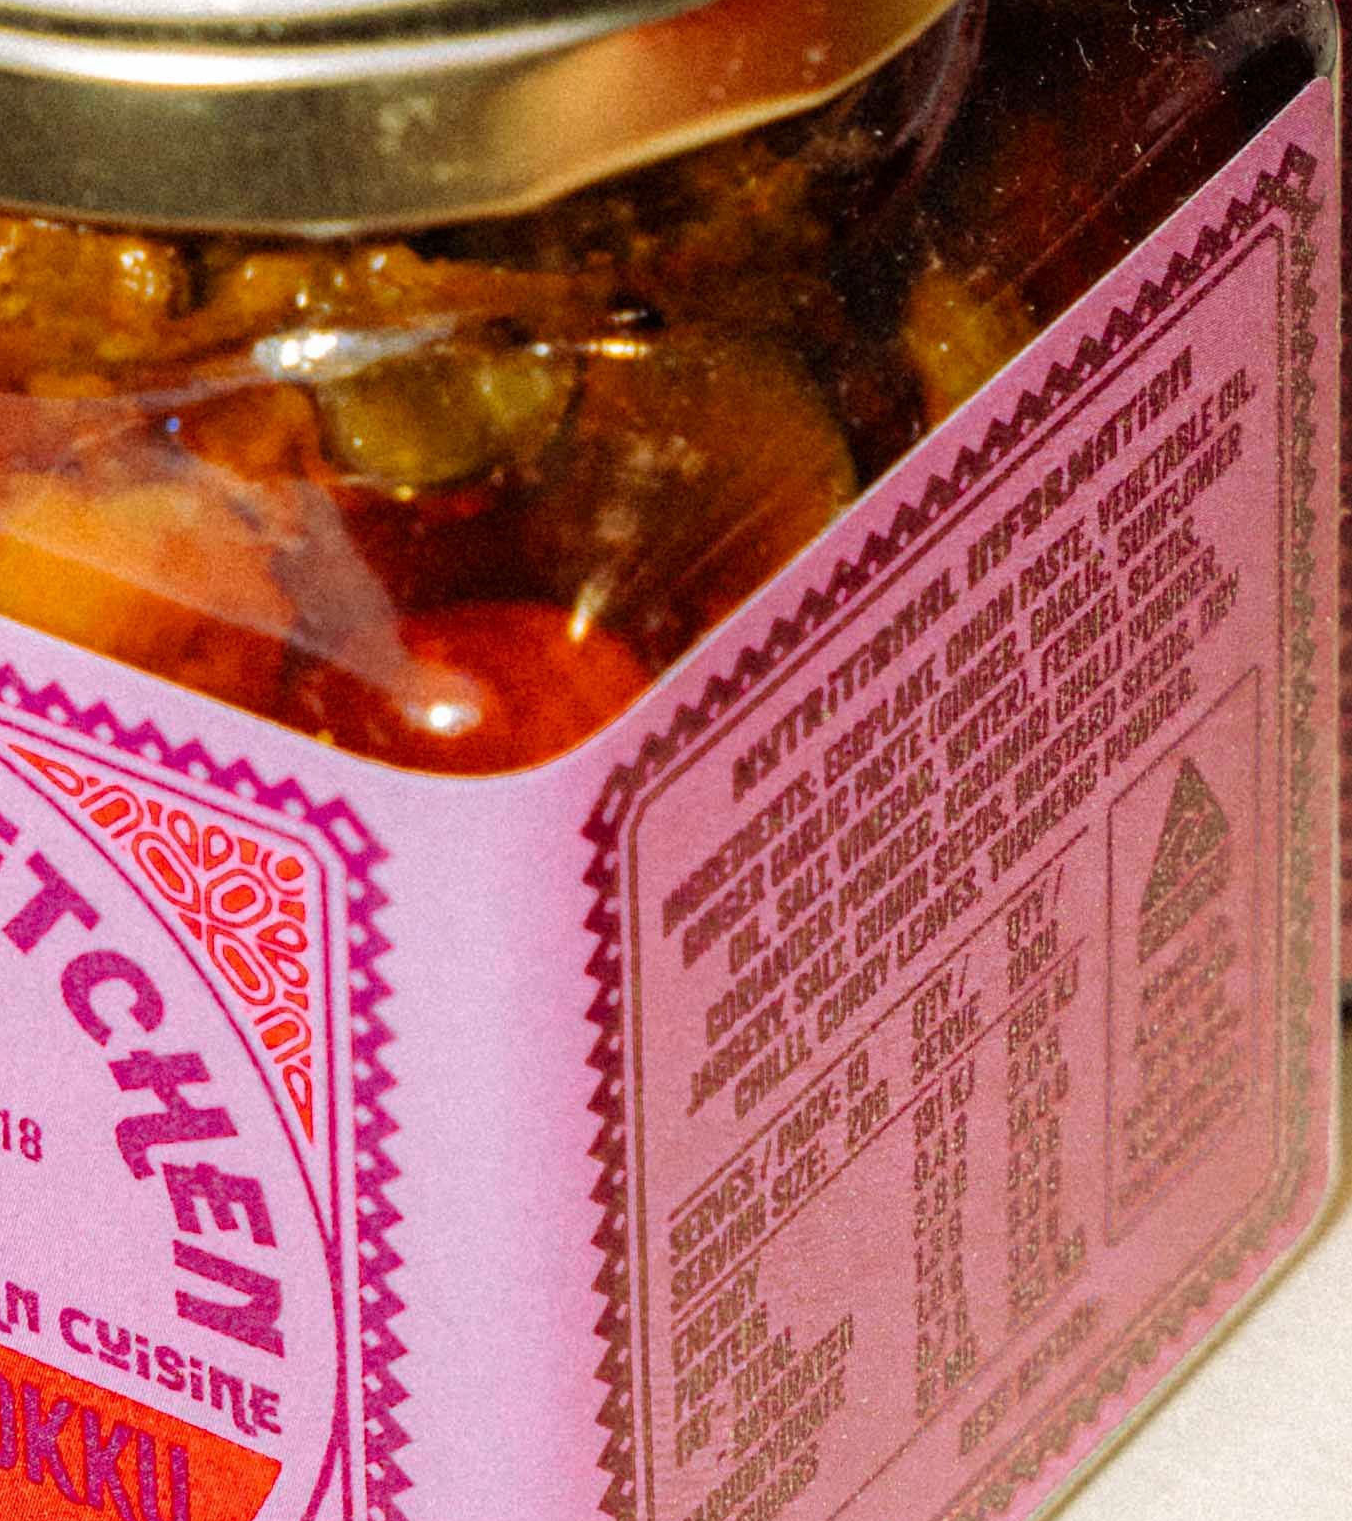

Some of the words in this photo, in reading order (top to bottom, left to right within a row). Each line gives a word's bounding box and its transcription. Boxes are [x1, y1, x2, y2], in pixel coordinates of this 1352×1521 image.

[966, 342, 1191, 594] INFORMATION
[1098, 395, 1212, 541] VEGETABLE
[60, 1305, 281, 1438] CUISINE
